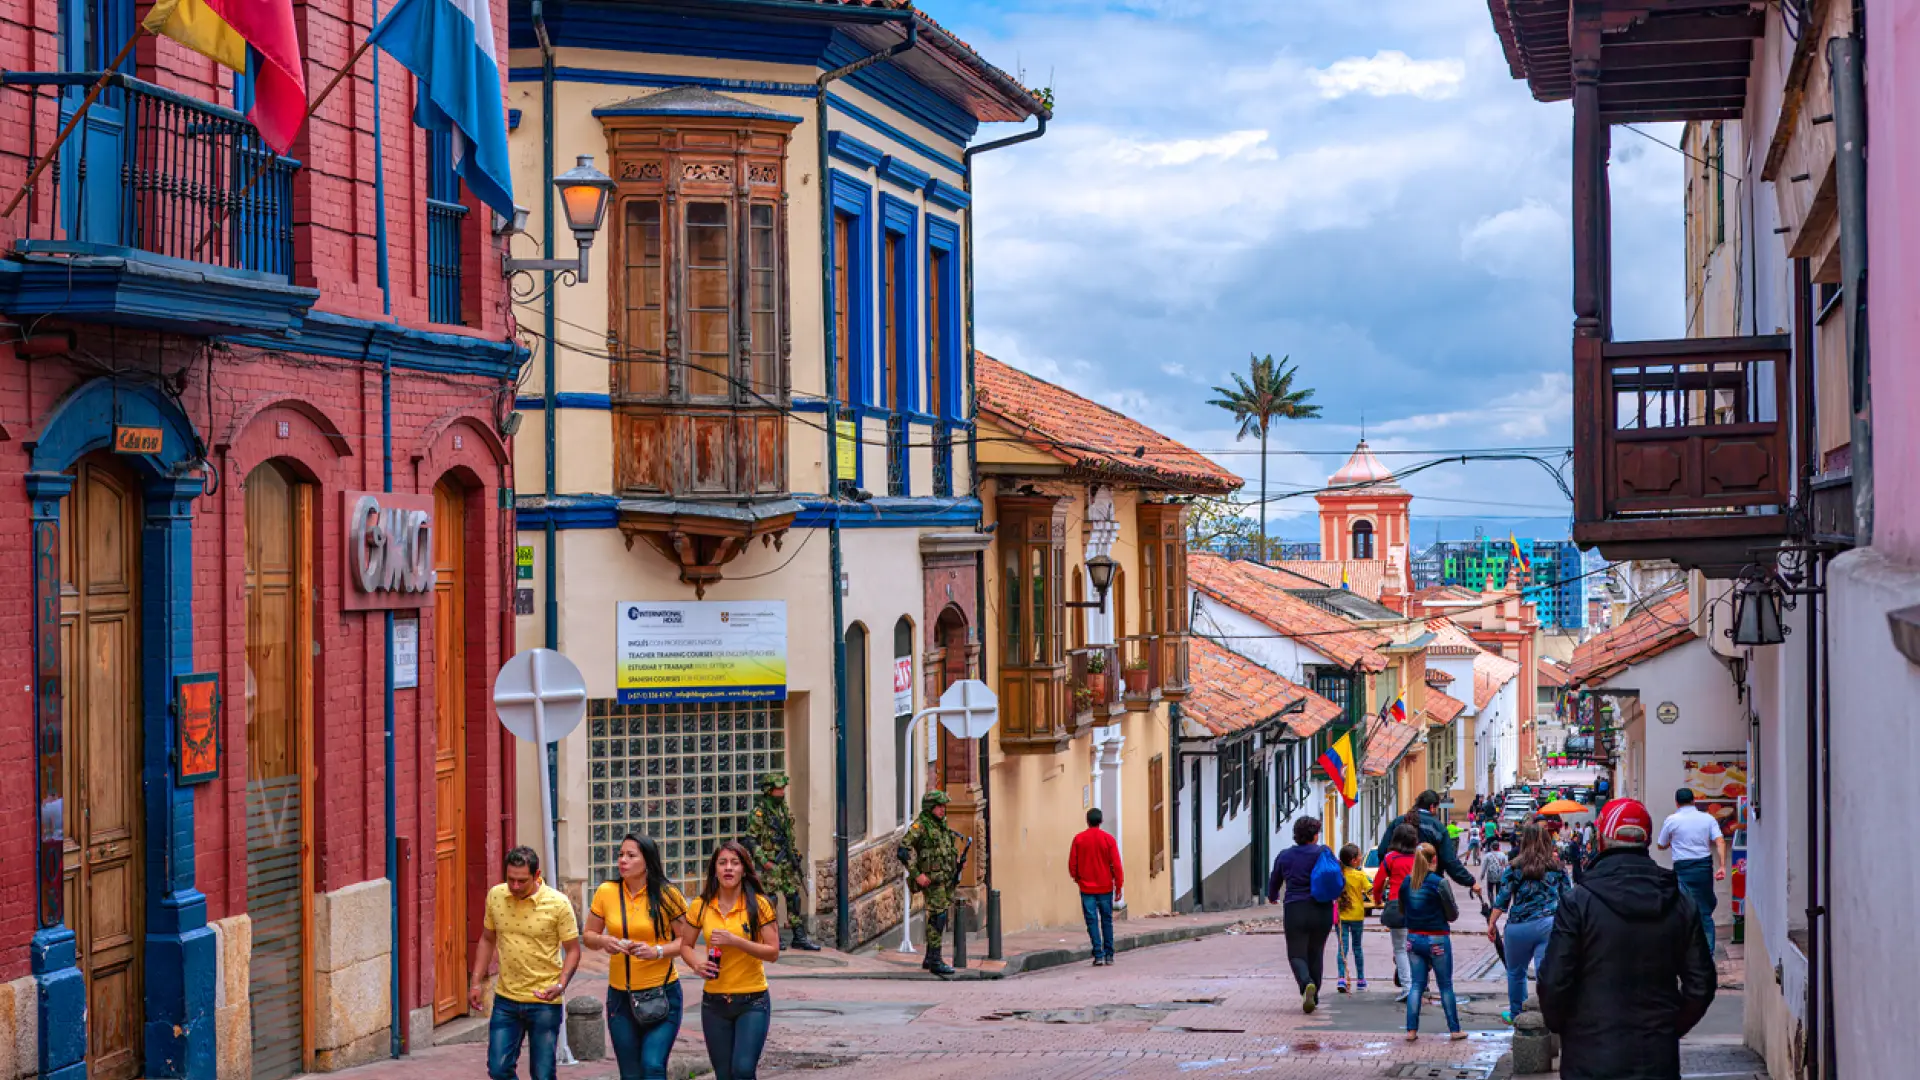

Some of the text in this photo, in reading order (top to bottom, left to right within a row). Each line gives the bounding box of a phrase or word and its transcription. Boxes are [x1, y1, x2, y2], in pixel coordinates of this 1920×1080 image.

[628, 651, 655, 659] TEACHER
[656, 651, 686, 659] TRAINING
[664, 663, 693, 671] TRABAJAR
